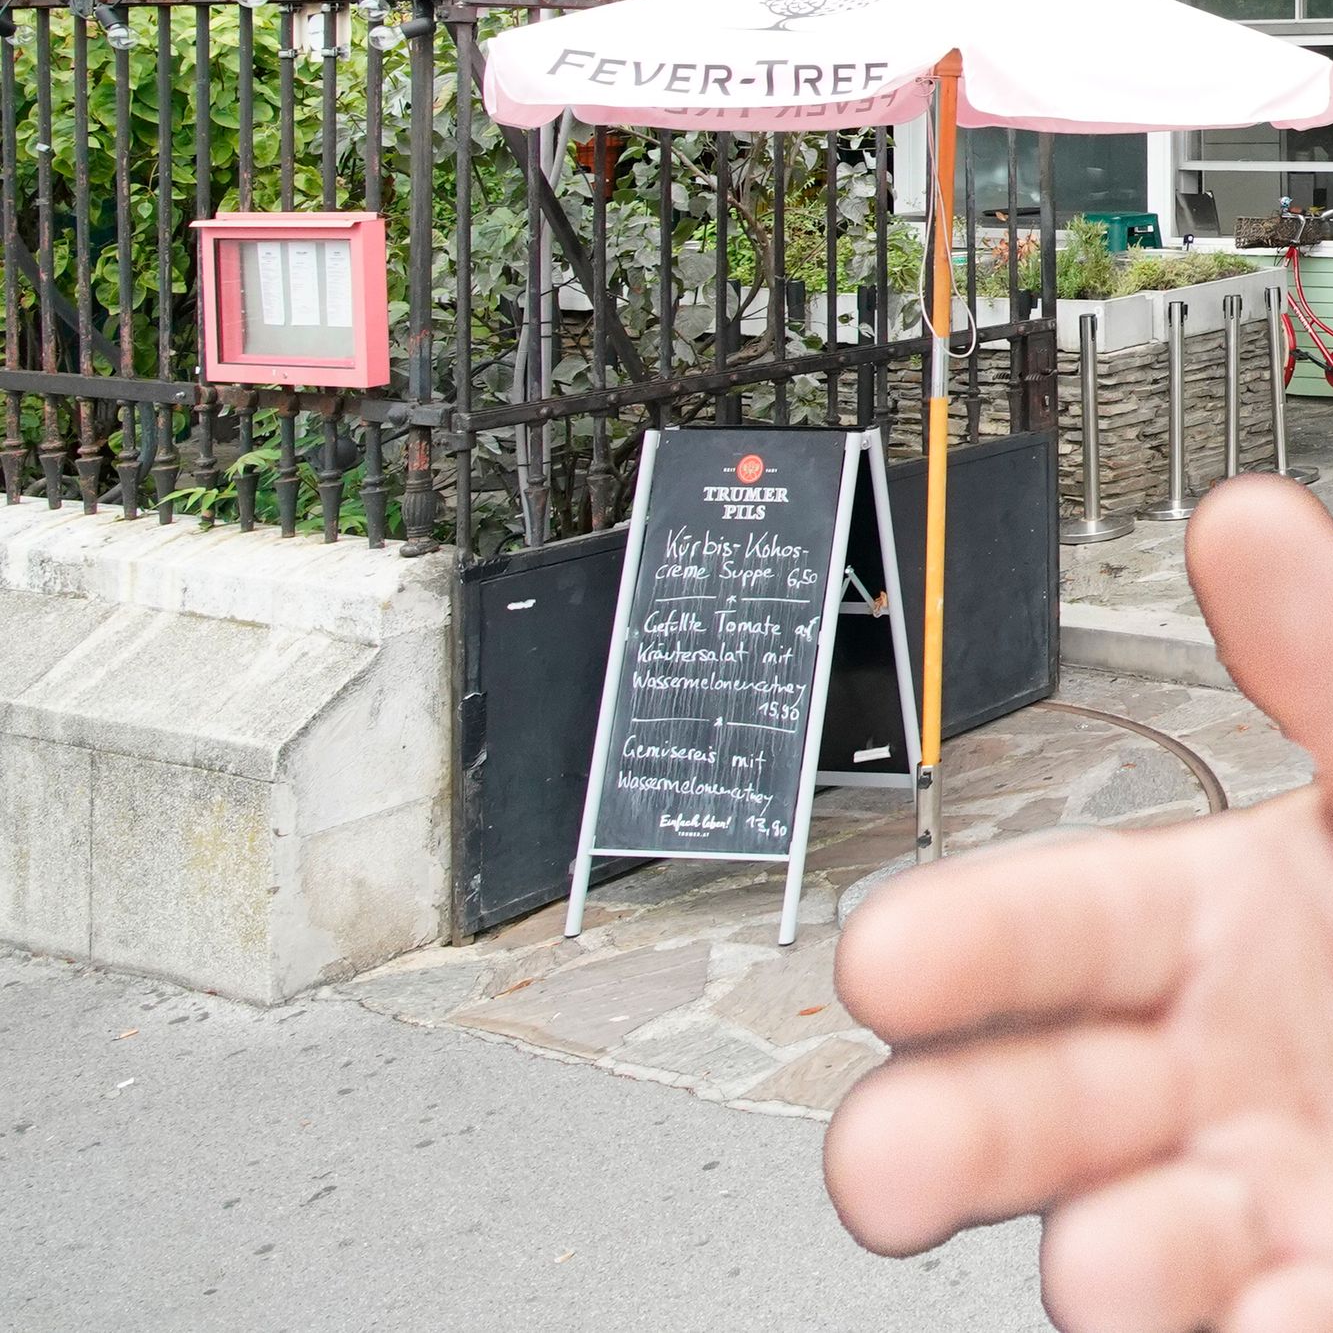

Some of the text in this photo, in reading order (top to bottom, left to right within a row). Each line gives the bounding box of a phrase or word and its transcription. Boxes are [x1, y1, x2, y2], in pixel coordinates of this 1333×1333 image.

[703, 486, 789, 503] TRUMER
[722, 504, 766, 521] PILS
[655, 564, 711, 581] creme
[719, 561, 775, 587] Suppe
[714, 610, 783, 636] Tomate
[762, 645, 794, 665] mit
[731, 750, 767, 769] mit
